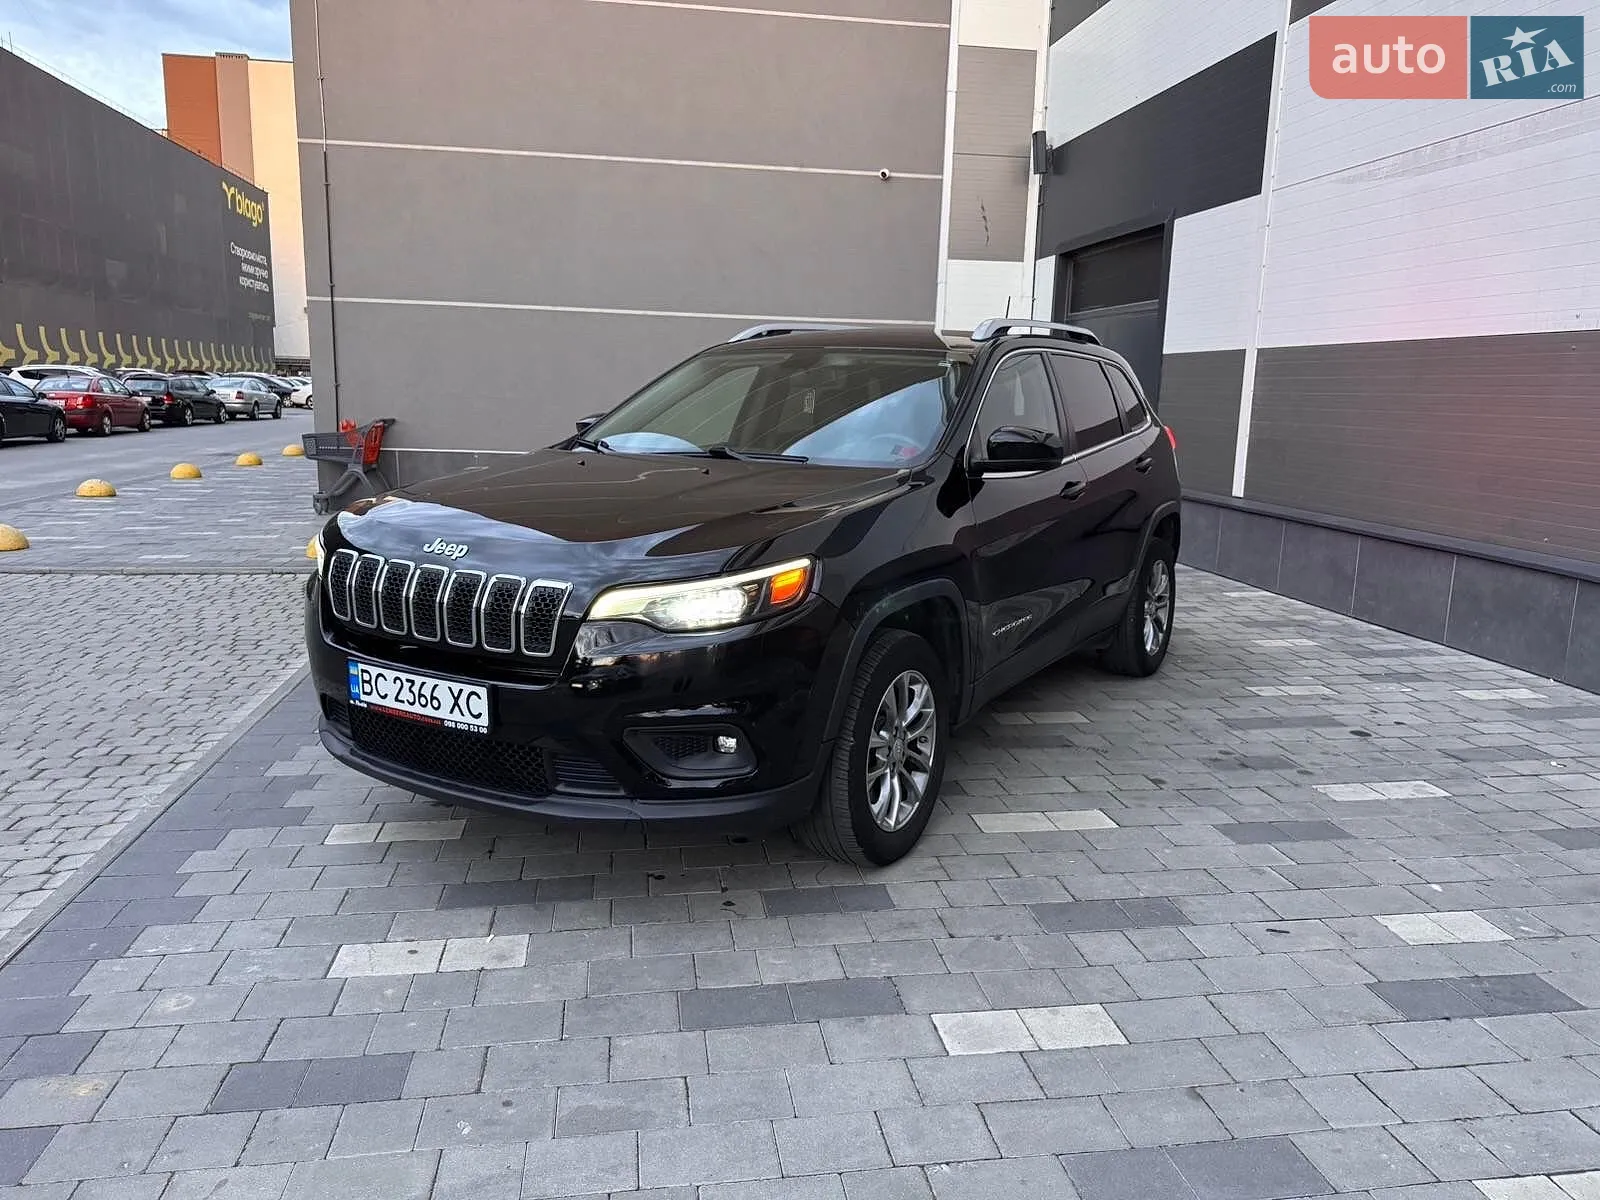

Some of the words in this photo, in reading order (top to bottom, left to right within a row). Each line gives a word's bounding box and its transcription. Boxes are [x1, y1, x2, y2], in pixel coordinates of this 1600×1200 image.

[423, 537, 469, 561] Jeep
[350, 684, 360, 693] UA
[360, 668, 389, 700] BC
[393, 676, 441, 711] 2366
[447, 685, 483, 719] XC
[479, 726, 488, 734] 00
